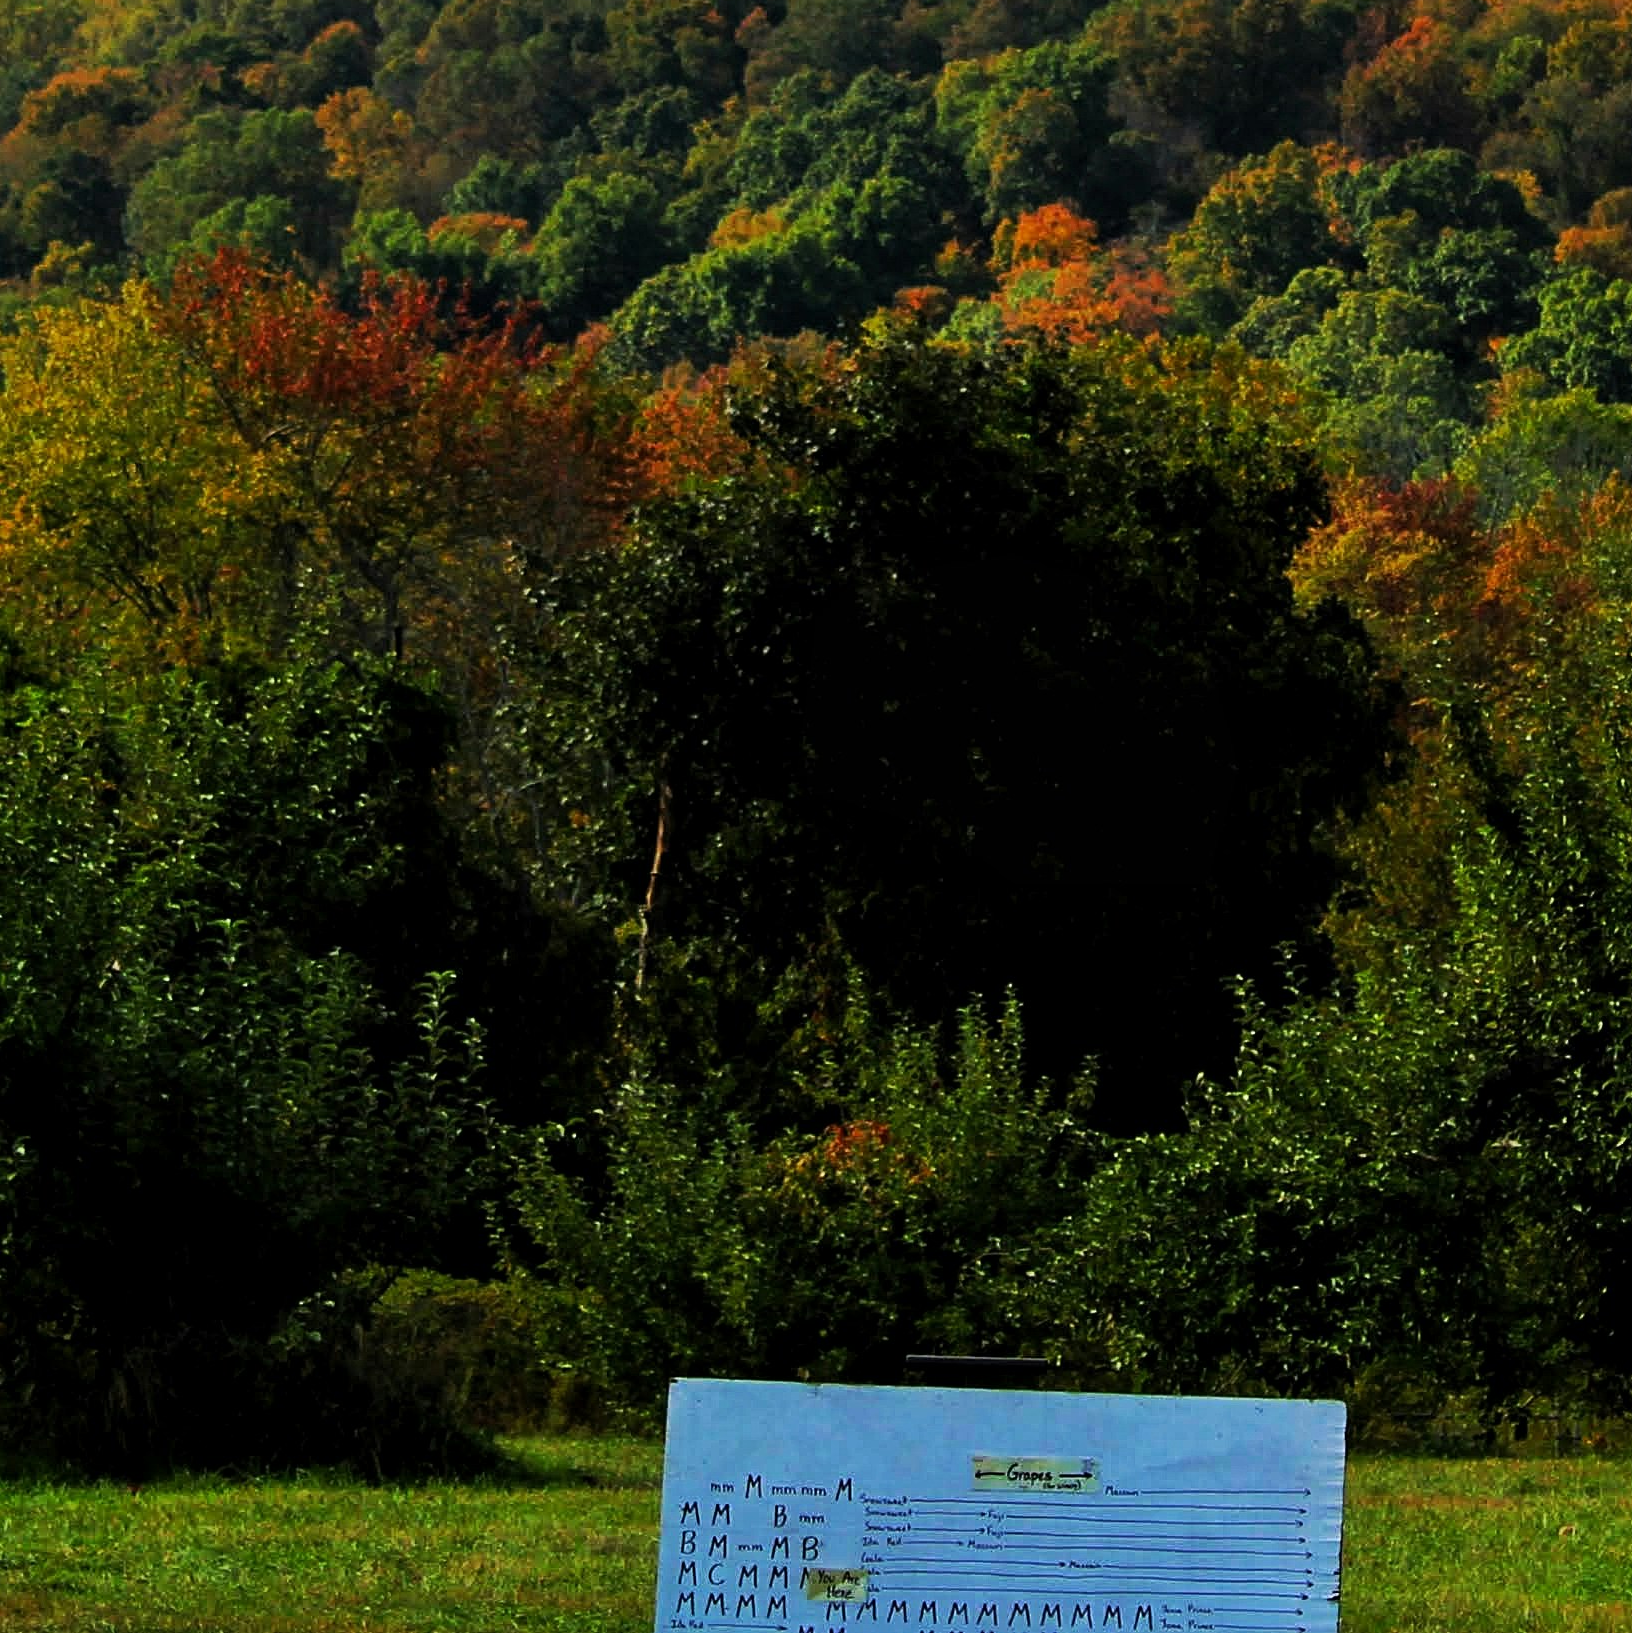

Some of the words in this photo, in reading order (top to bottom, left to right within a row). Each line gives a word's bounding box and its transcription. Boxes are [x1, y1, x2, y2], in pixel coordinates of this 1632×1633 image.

[1007, 1462, 1053, 1485] Grapes
[745, 1474, 762, 1498] M
[835, 1478, 852, 1501] M
[681, 1501, 700, 1525] M
[712, 1503, 730, 1525] M
[774, 1504, 787, 1528] B
[681, 1530, 696, 1554] B
[709, 1535, 727, 1558] M
[771, 1536, 789, 1559] M
[802, 1536, 818, 1561] B
[679, 1562, 696, 1586] M
[708, 1564, 725, 1585] C
[739, 1565, 757, 1587] M
[769, 1566, 787, 1589] M
[818, 1569, 836, 1584] You
[842, 1570, 861, 1585] Are
[826, 1584, 855, 1599] Here
[677, 1592, 695, 1616] M
[705, 1593, 725, 1616] M
[737, 1595, 756, 1617] M
[767, 1595, 786, 1618] M
[827, 1601, 846, 1621] M
[857, 1598, 876, 1620] M
[887, 1600, 907, 1623] M
[919, 1601, 937, 1624] M
[948, 1602, 968, 1624] M
[977, 1603, 998, 1626] M
[1009, 1603, 1030, 1627] M
[1040, 1603, 1061, 1627] M
[1071, 1604, 1092, 1628] M
[1103, 1605, 1122, 1628] M
[1134, 1605, 1153, 1630] M
